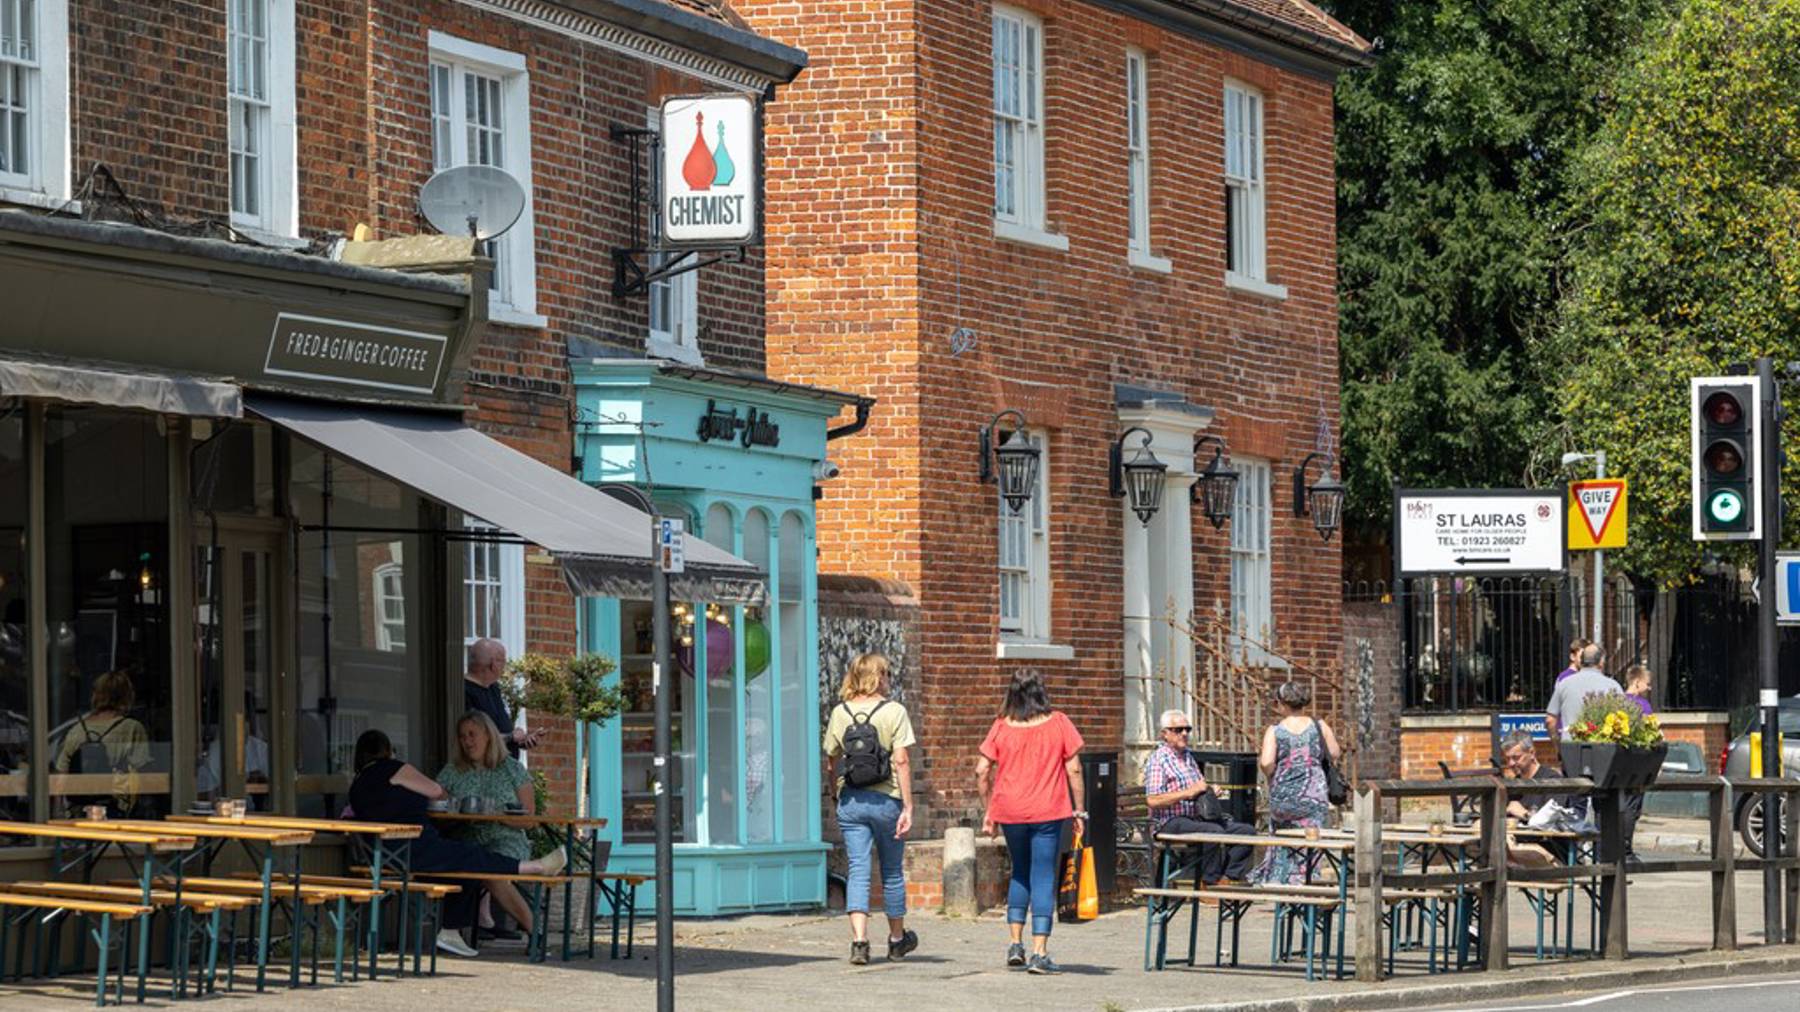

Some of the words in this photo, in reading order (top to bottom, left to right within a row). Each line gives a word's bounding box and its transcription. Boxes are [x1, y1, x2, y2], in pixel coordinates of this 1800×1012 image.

[669, 195, 745, 226] CHEMIST
[286, 332, 321, 358] FRED
[329, 338, 379, 364] GINGER
[379, 345, 428, 371] COFFEE
[1582, 491, 1611, 504] GIVE
[1589, 507, 1606, 515] WAY
[1436, 514, 1456, 527] ST
[1461, 514, 1527, 527] LAURAS
[1437, 536, 1459, 546] TEL:
[1462, 536, 1490, 546] 01923
